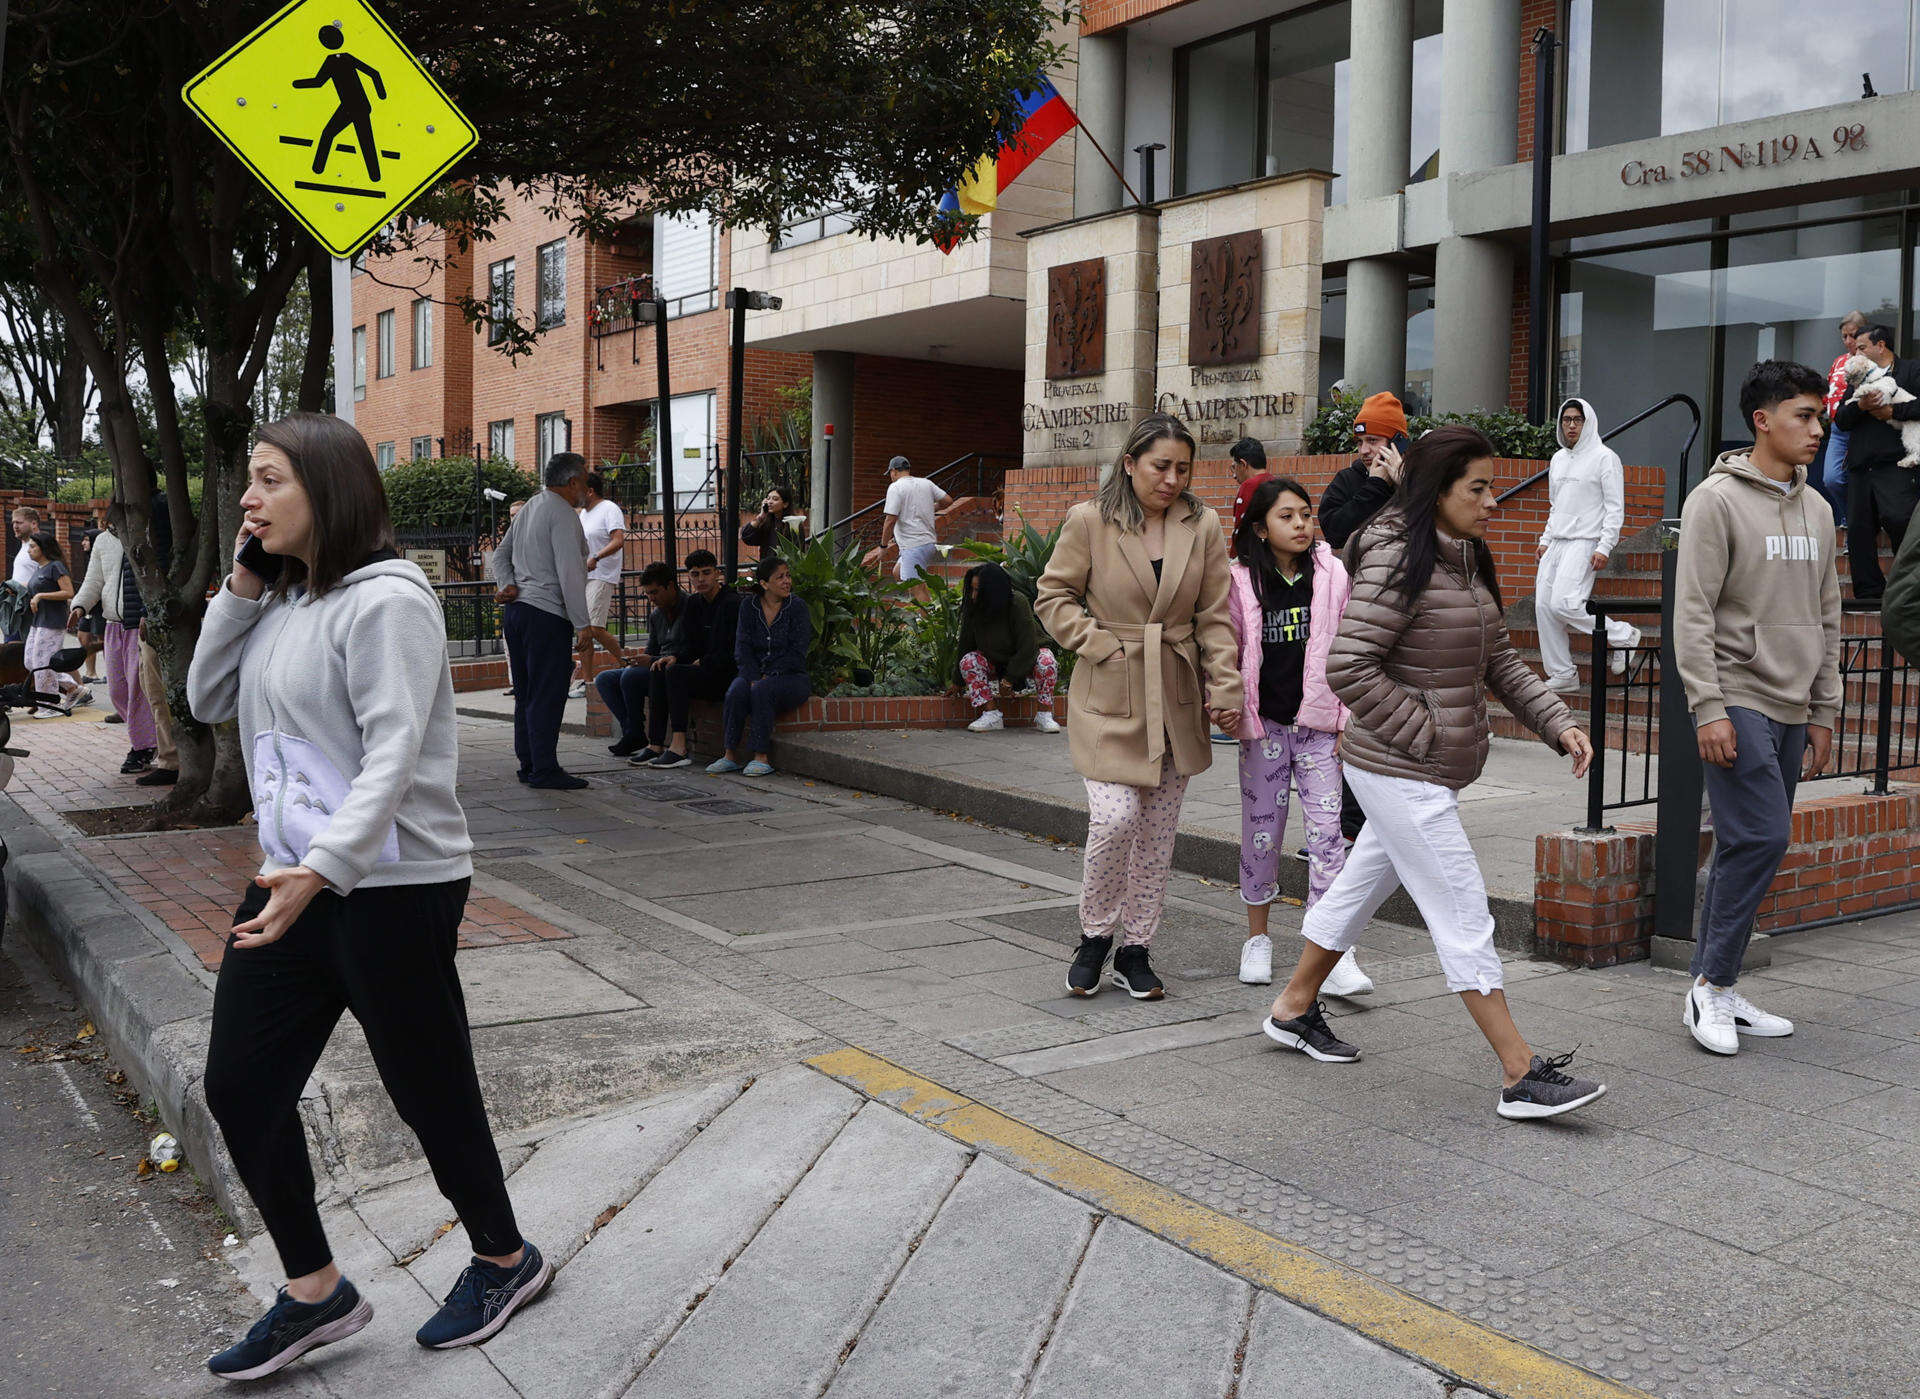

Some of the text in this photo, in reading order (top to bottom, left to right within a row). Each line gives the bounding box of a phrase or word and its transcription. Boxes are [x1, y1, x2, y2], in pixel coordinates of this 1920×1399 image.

[1680, 149, 1711, 178] 58
[1832, 123, 1869, 154] 98
[1022, 402, 1129, 432] CAMPESTRE
[1158, 391, 1296, 422] CAMPESTRE
[1765, 535, 1819, 561] PUMA
